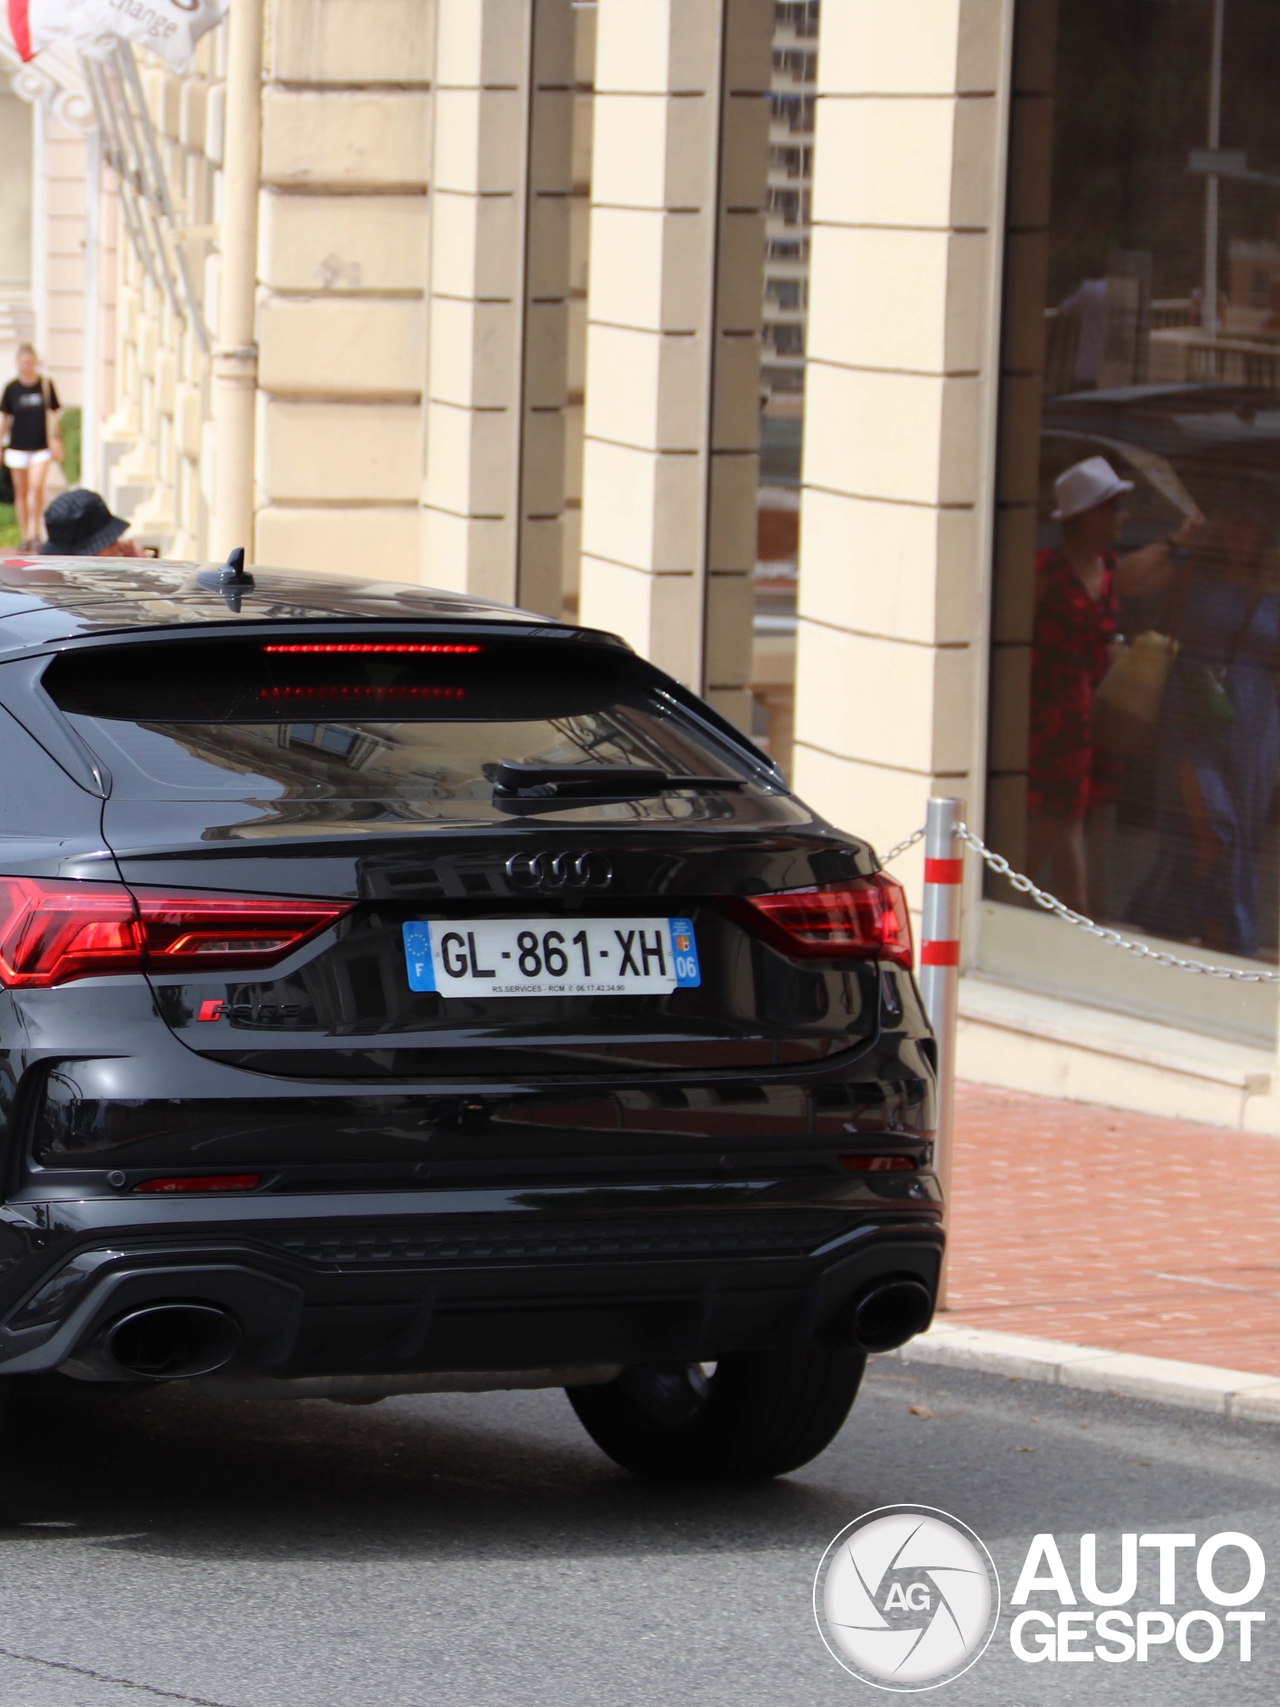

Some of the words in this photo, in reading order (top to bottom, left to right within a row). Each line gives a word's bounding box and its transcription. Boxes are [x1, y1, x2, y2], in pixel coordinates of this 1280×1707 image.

[440, 930, 667, 978] GL-861-XH
[414, 963, 424, 977] F
[676, 956, 697, 979] 06
[492, 985, 542, 993] RS.SERVICES
